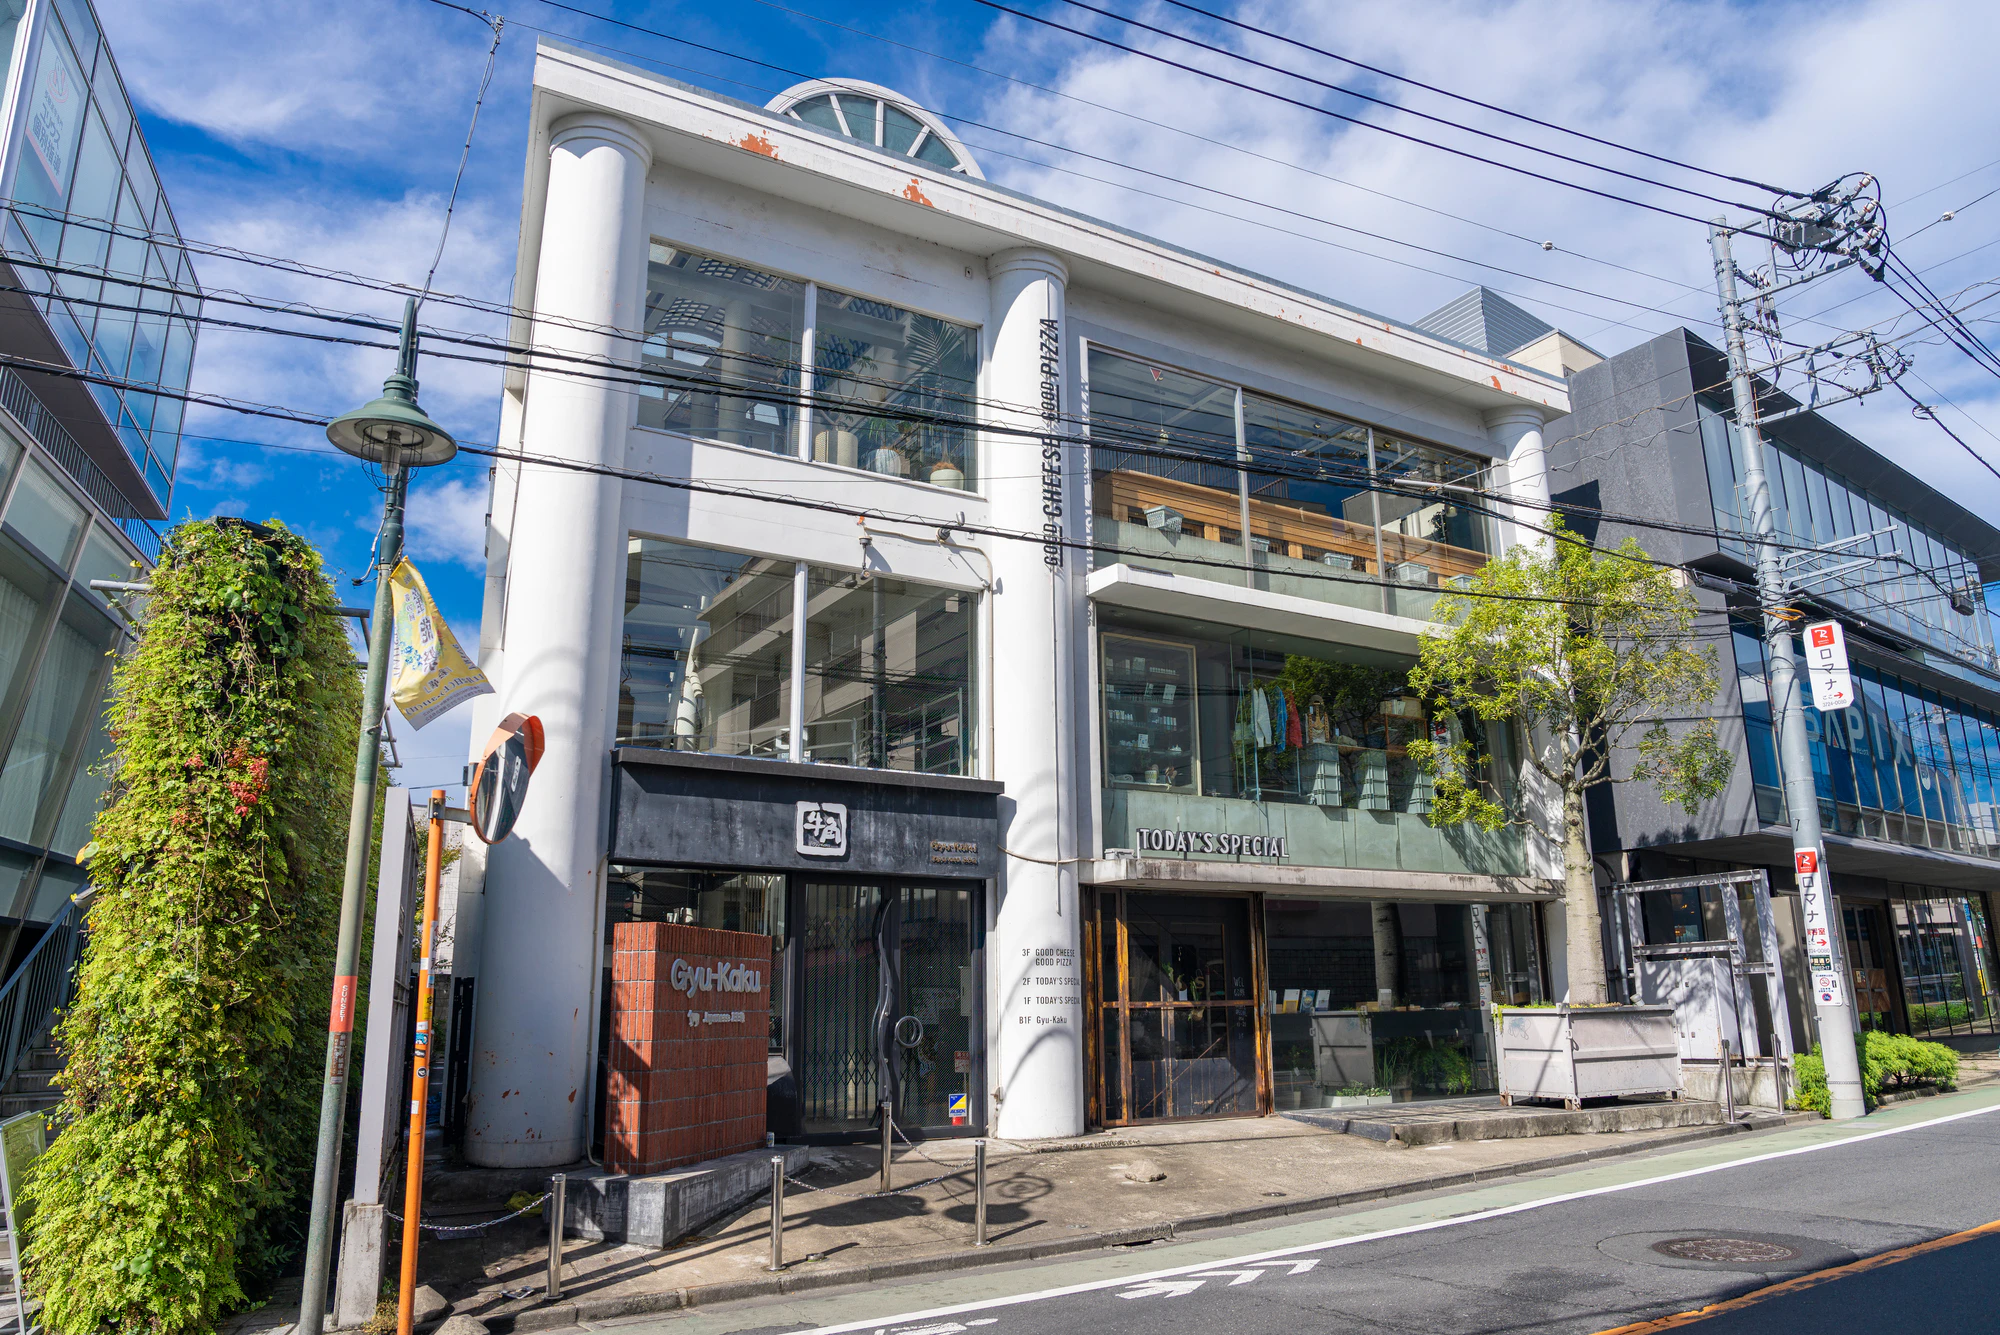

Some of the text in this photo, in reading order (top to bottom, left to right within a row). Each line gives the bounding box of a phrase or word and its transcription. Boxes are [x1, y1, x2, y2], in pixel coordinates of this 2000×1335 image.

[1039, 319, 1059, 377] PIZZA
[1041, 381, 1058, 421] GOOD
[1042, 435, 1063, 517] CHEESE
[1820, 648, 1837, 690] ロマナ
[803, 811, 841, 844] 牛角
[1137, 828, 1290, 857] TODAY'S SPECIAL
[1802, 876, 1819, 923] ロマナ
[1035, 958, 1072, 966] GOOD PIZZA
[1056, 949, 1075, 957] CHEESE
[671, 958, 761, 998] Gyu-Kaku
[1022, 978, 1031, 986] 2F
[1035, 977, 1062, 985] TODAY'S
[340, 985, 348, 1022] SUNSET
[1019, 1016, 1067, 1025] B1F Gyu-Kaku
